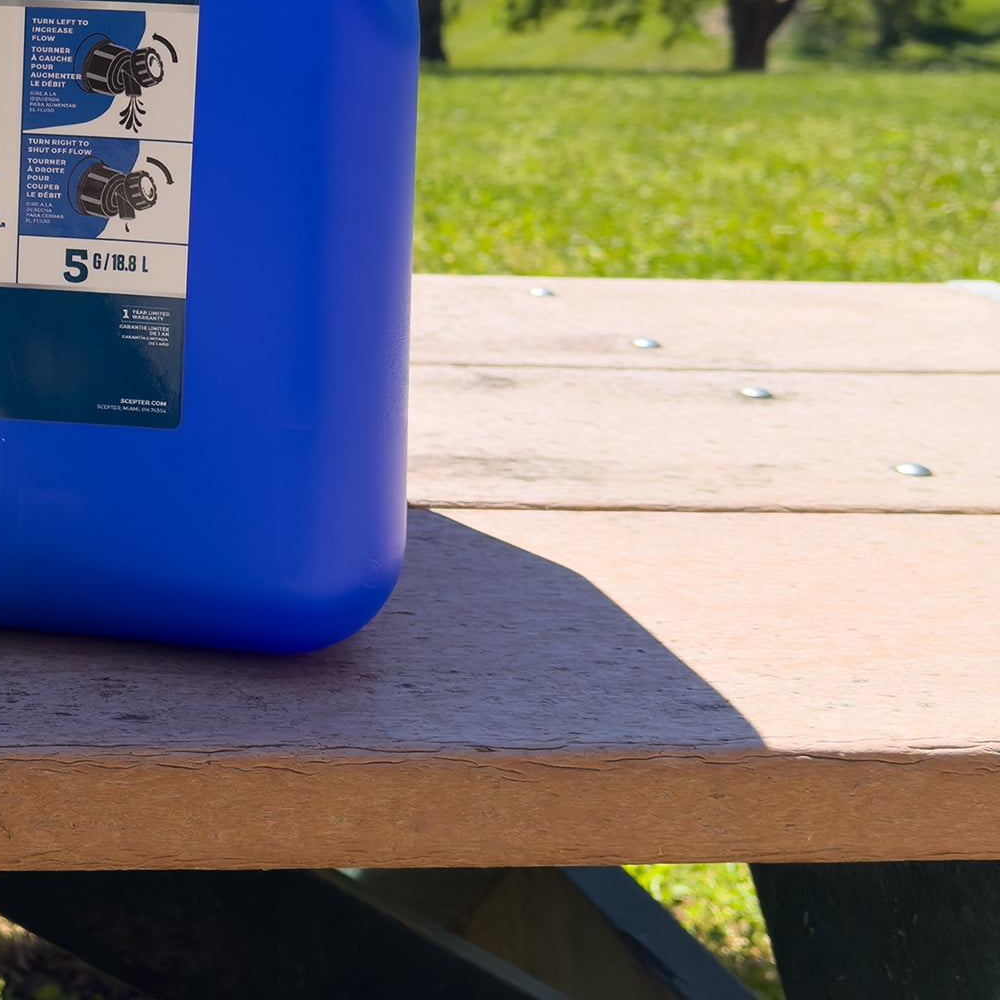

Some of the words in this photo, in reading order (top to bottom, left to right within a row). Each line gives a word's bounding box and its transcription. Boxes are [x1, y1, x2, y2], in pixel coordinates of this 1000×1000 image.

[63, 248, 88, 283] 5
[142, 256, 148, 272] L
[123, 309, 129, 319] 1
[120, 398, 167, 407] SCEPTER.COM
